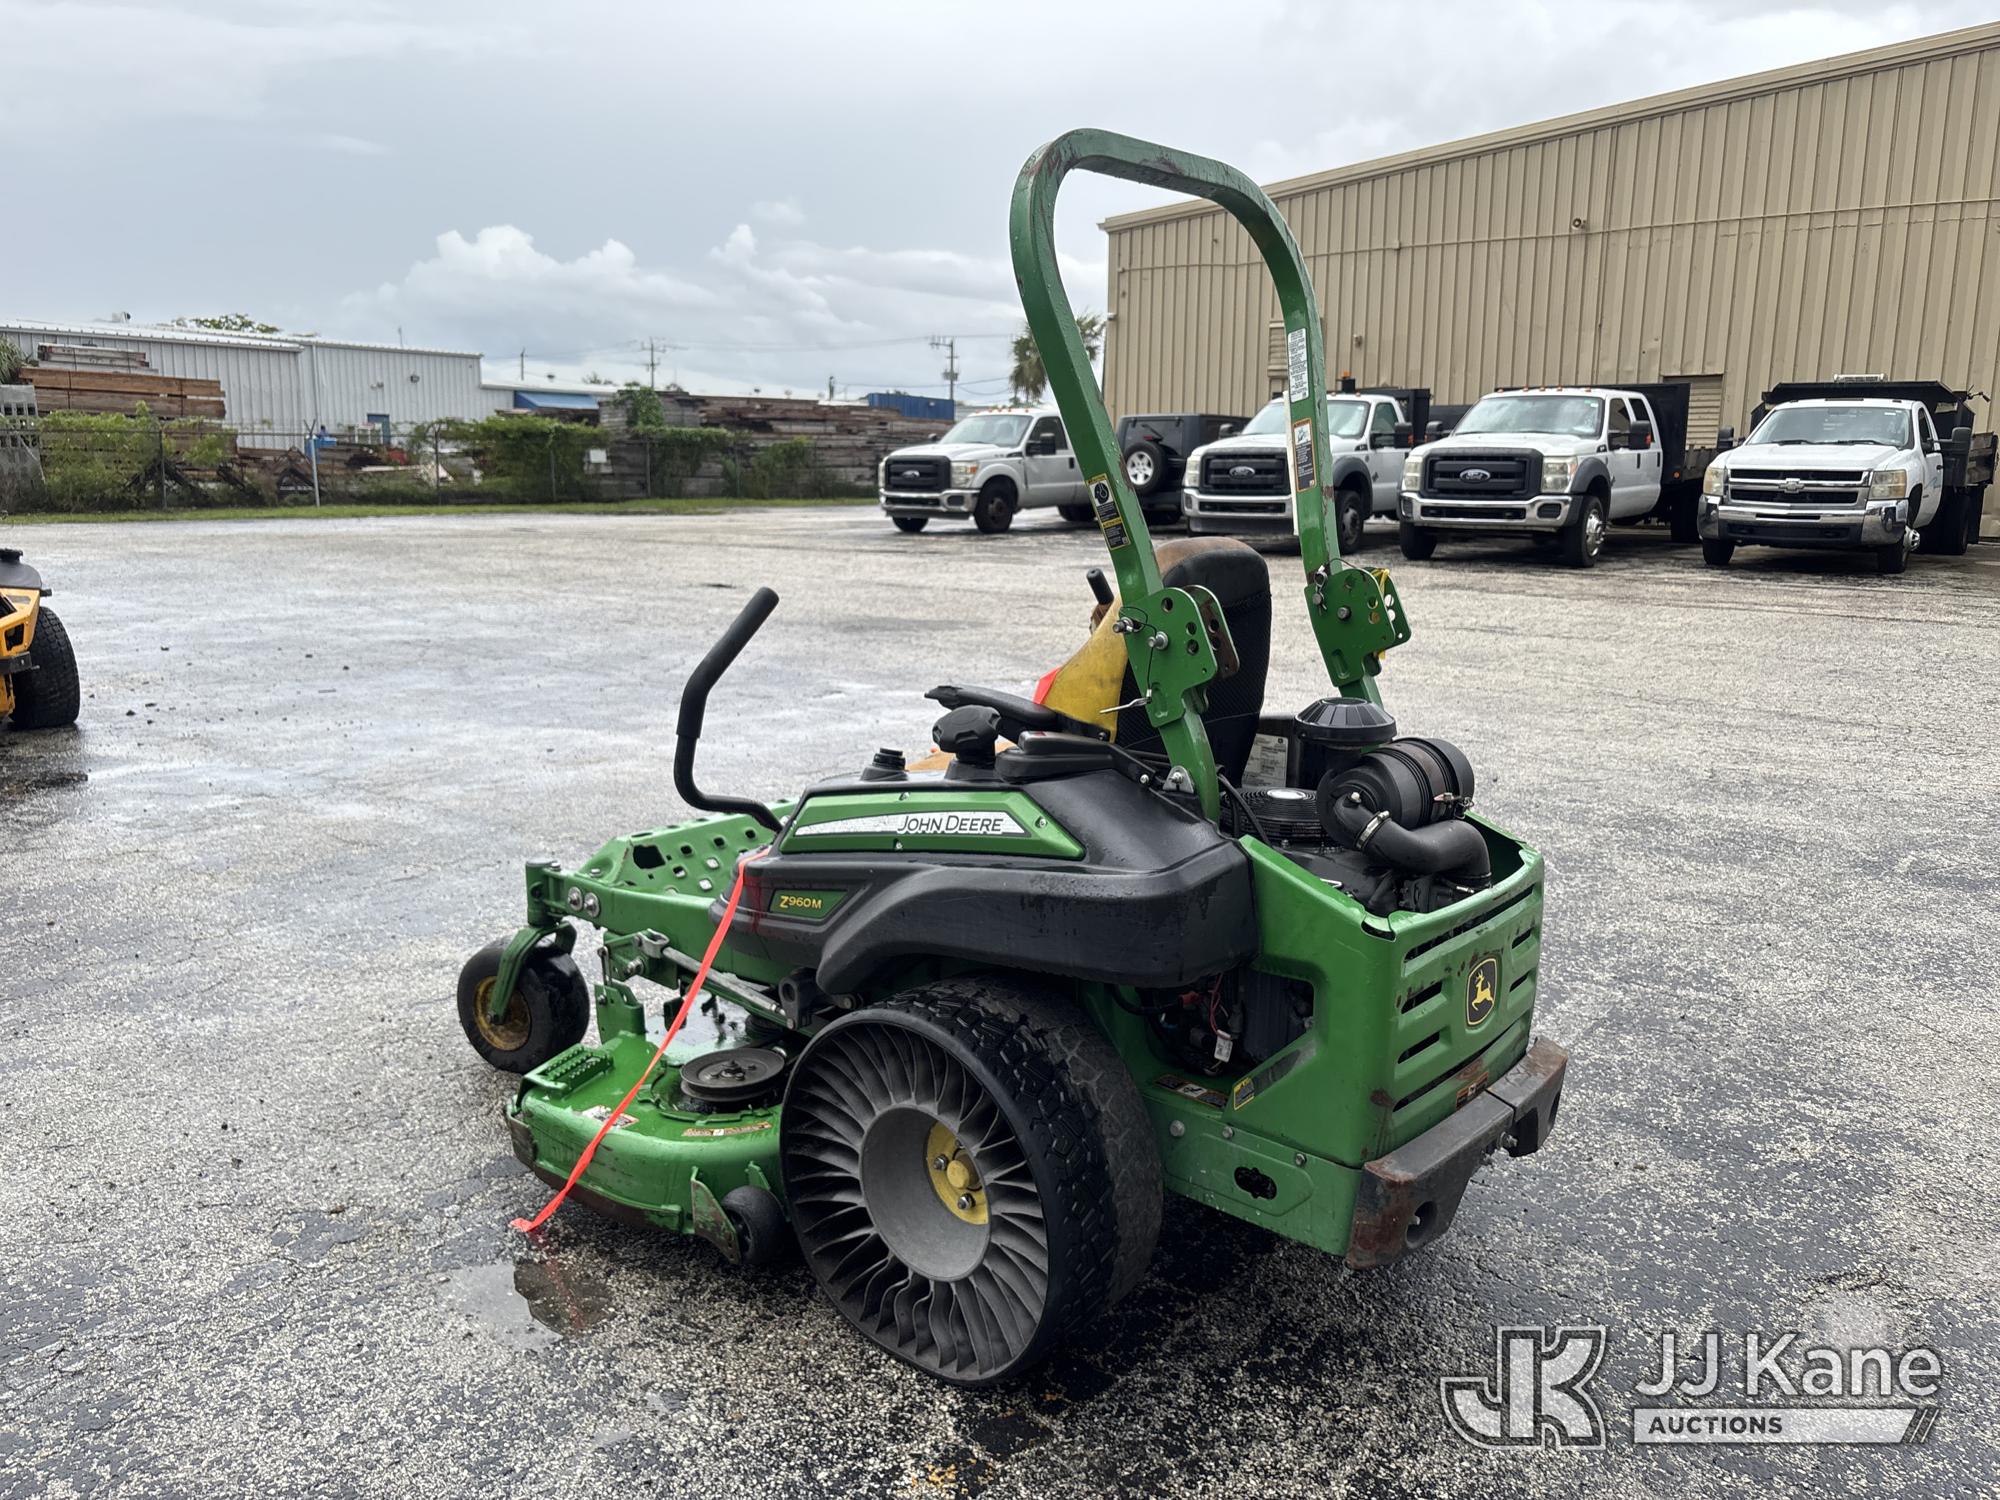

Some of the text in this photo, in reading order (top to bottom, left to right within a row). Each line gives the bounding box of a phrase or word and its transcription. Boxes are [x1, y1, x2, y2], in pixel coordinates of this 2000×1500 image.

[897, 815, 1004, 832] JOHN DEERE
[780, 895, 822, 909] Z960M
